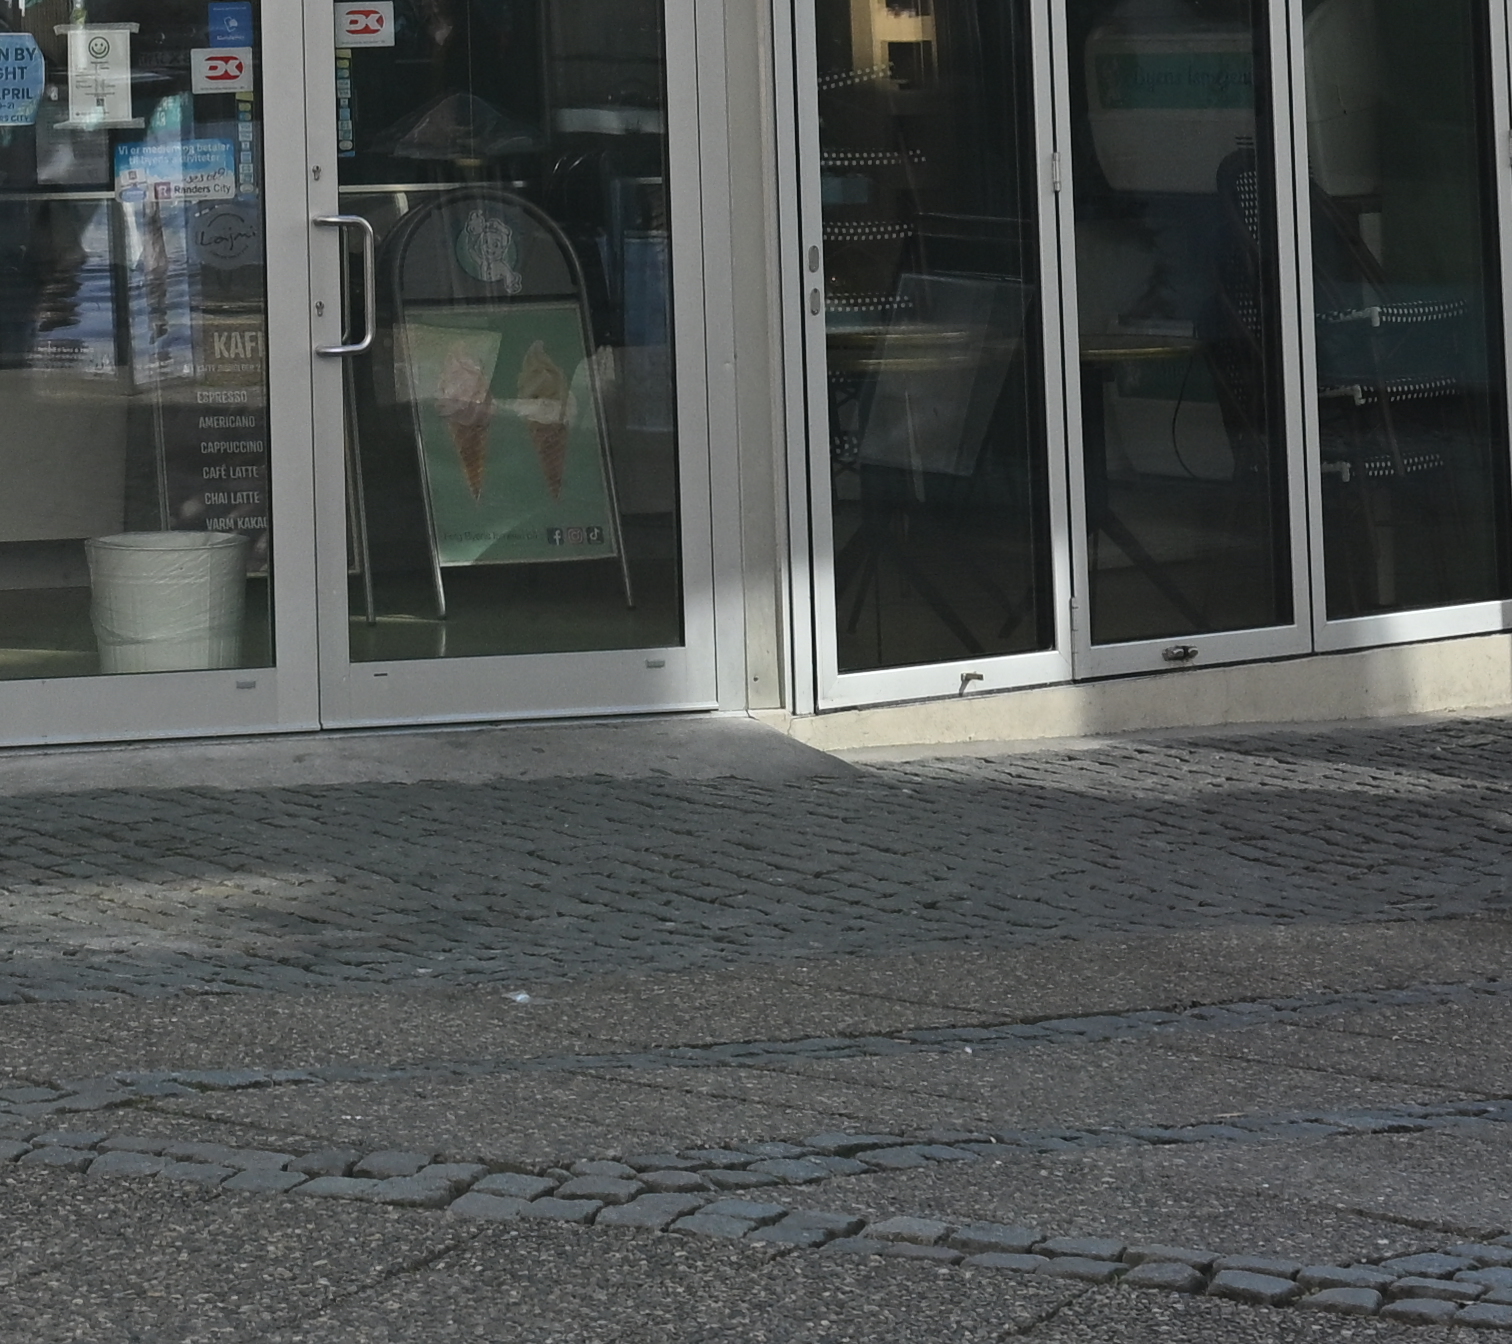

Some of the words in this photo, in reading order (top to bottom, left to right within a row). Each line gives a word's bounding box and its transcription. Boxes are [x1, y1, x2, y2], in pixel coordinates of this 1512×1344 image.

[14, 47, 38, 61] BY
[174, 185, 211, 194] Randers
[214, 183, 231, 194] City
[197, 390, 248, 404] ESPRESSO
[198, 415, 256, 429] AMERICANO
[200, 440, 264, 454] CAPPUCCINO
[202, 463, 227, 479] CAFÉ
[230, 466, 260, 479] LATTE
[204, 492, 228, 505] CHAI
[230, 491, 260, 504] LATTE
[205, 517, 235, 530] VARM
